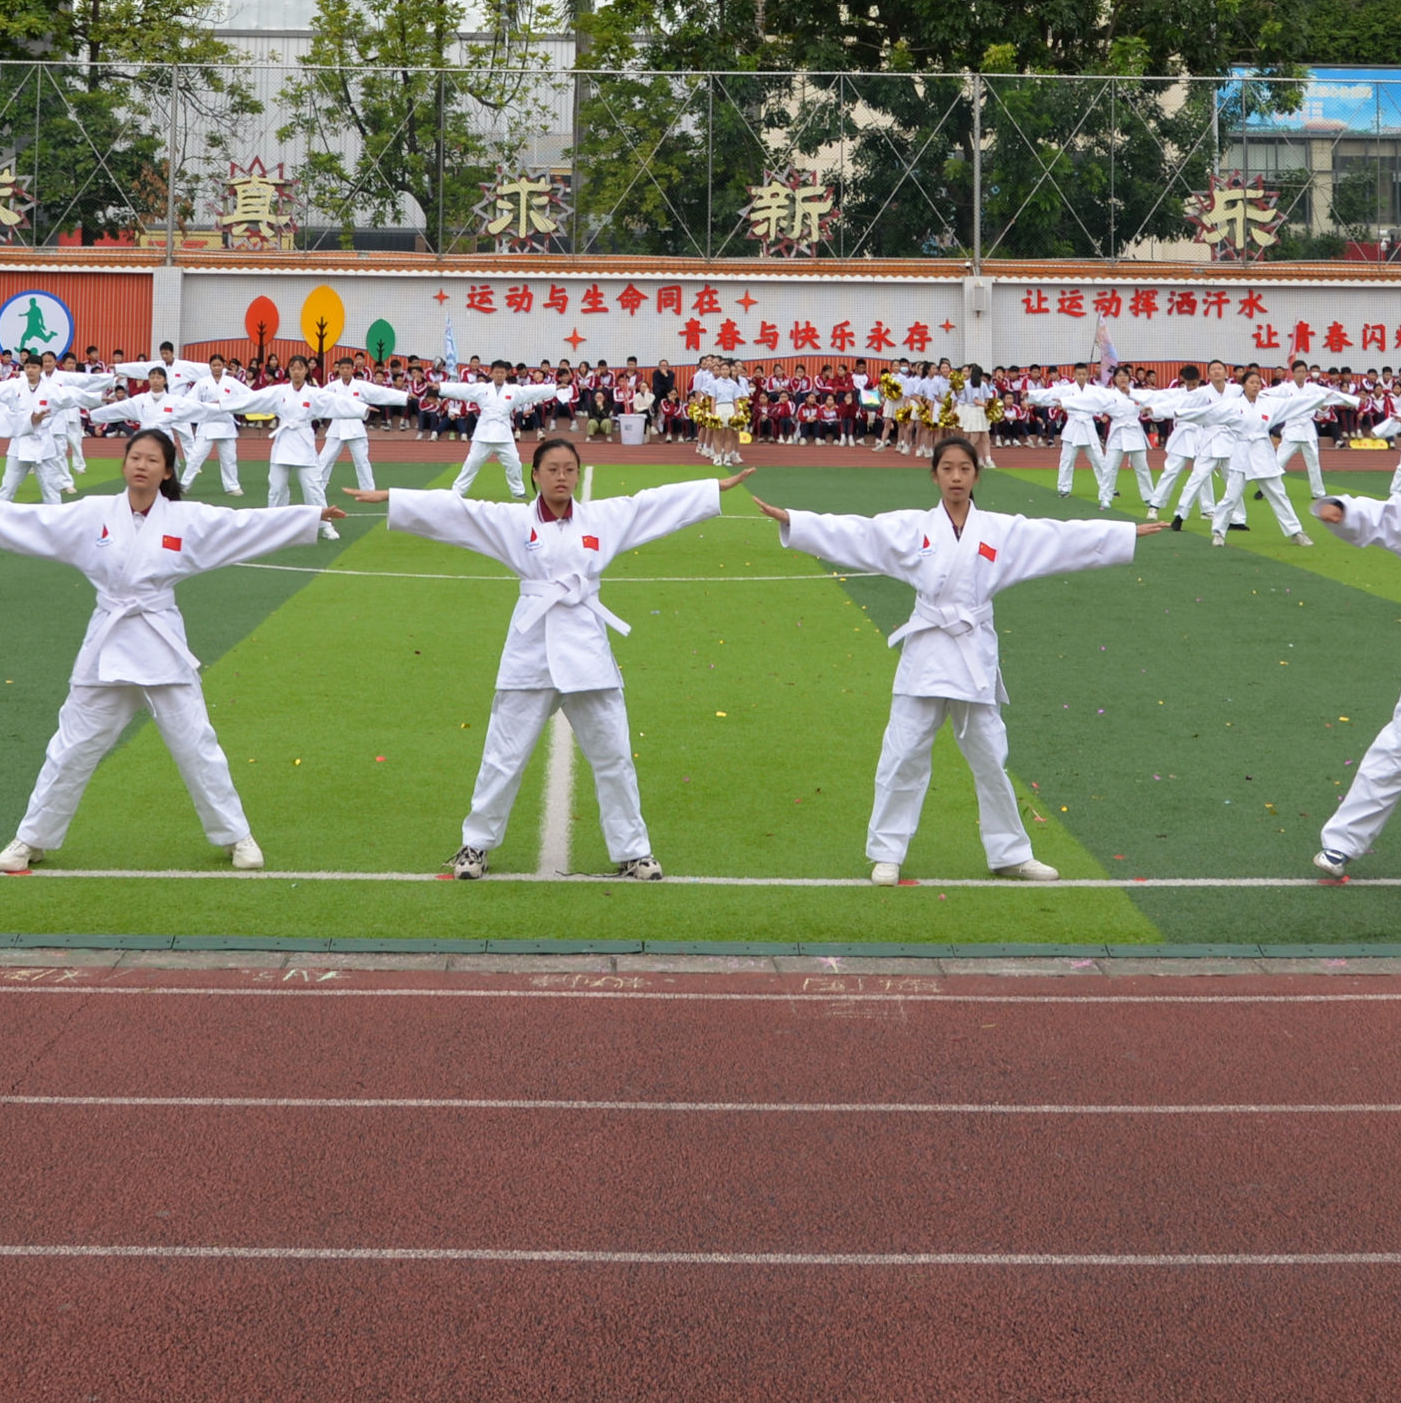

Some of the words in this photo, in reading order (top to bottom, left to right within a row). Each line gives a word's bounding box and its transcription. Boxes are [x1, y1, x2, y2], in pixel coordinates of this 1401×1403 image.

[219, 174, 291, 239] 真
[486, 176, 558, 238] 求
[750, 182, 833, 243] 新
[466, 284, 723, 315] 运动与生命同在
[1022, 289, 1268, 318] 让运动挥洒汗水
[679, 318, 932, 353] 青春与快乐永存
